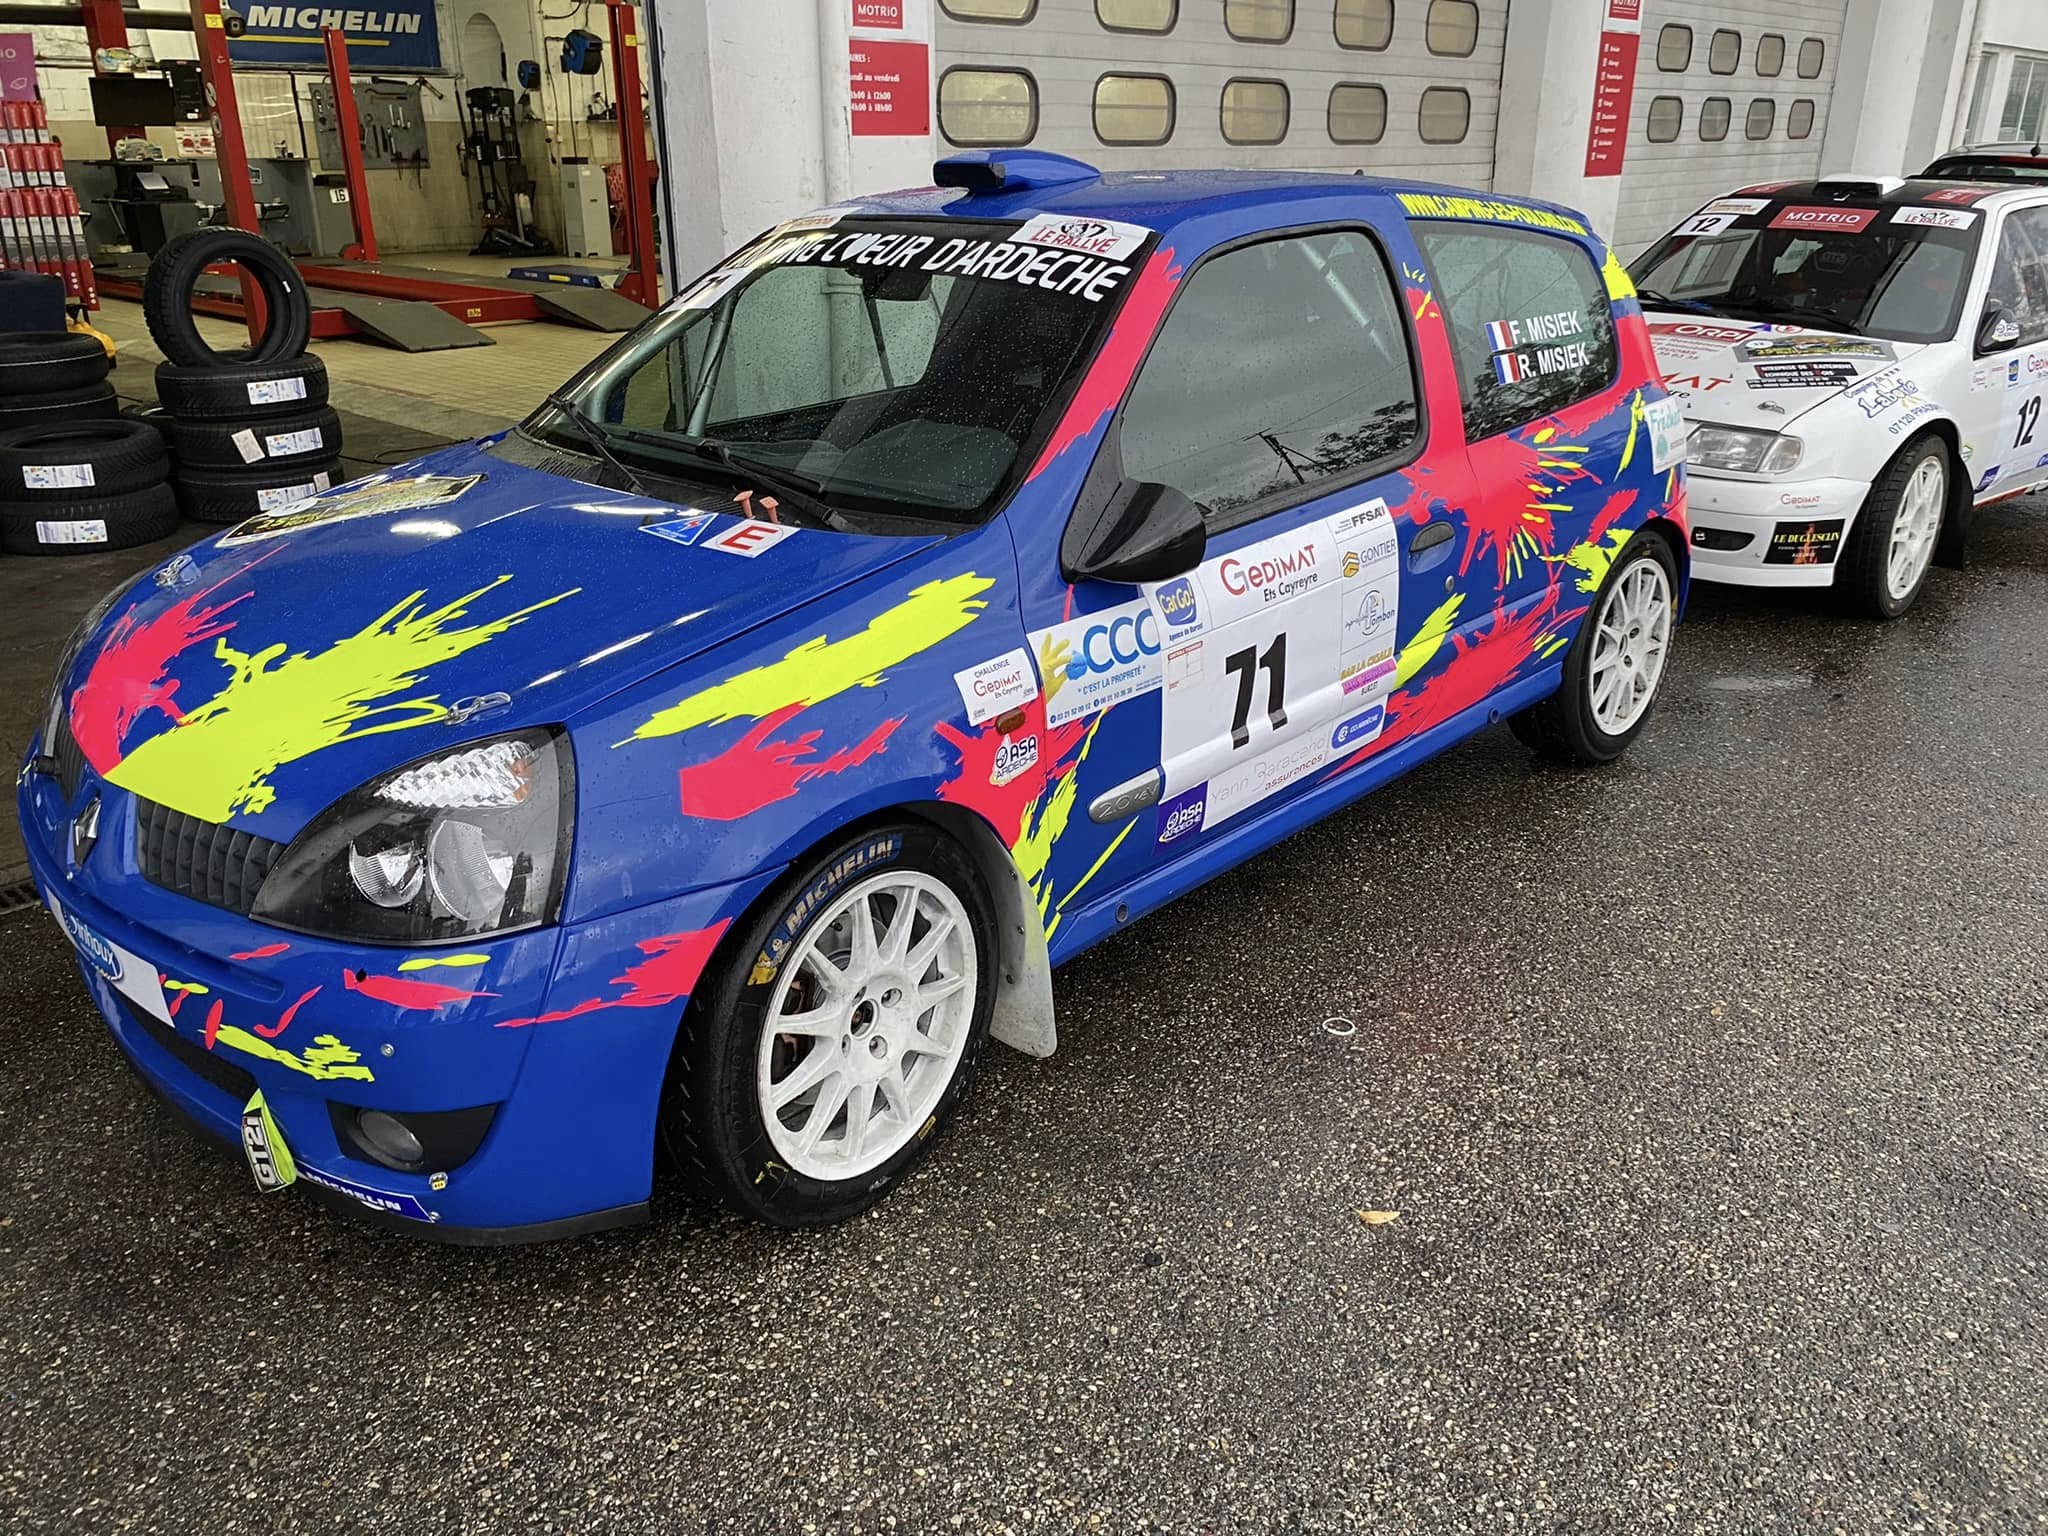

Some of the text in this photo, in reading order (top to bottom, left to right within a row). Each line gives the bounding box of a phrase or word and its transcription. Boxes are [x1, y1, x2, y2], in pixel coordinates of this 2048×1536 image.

[247, 5, 421, 34] MICHELIN
[1689, 217, 1722, 233] 12
[1053, 234, 1121, 253] RALLYE
[1509, 310, 1583, 345] F. MISIEK
[1674, 325, 1747, 341] ORPI
[1518, 342, 1590, 379] R. MISIEK
[1888, 412, 1916, 435] 07120
[2013, 395, 2041, 449] 12
[720, 525, 779, 551] E
[1360, 538, 1397, 563] GONTIER
[1278, 573, 1318, 596] Cayreyre
[1082, 607, 1162, 674] CCC
[974, 658, 1011, 679] CHALLENGE
[1225, 632, 1289, 751] 71
[1009, 736, 1038, 760] ASA
[995, 751, 1038, 781] ARDECHE
[1264, 753, 1323, 791] assurances
[1180, 800, 1203, 824] ASA
